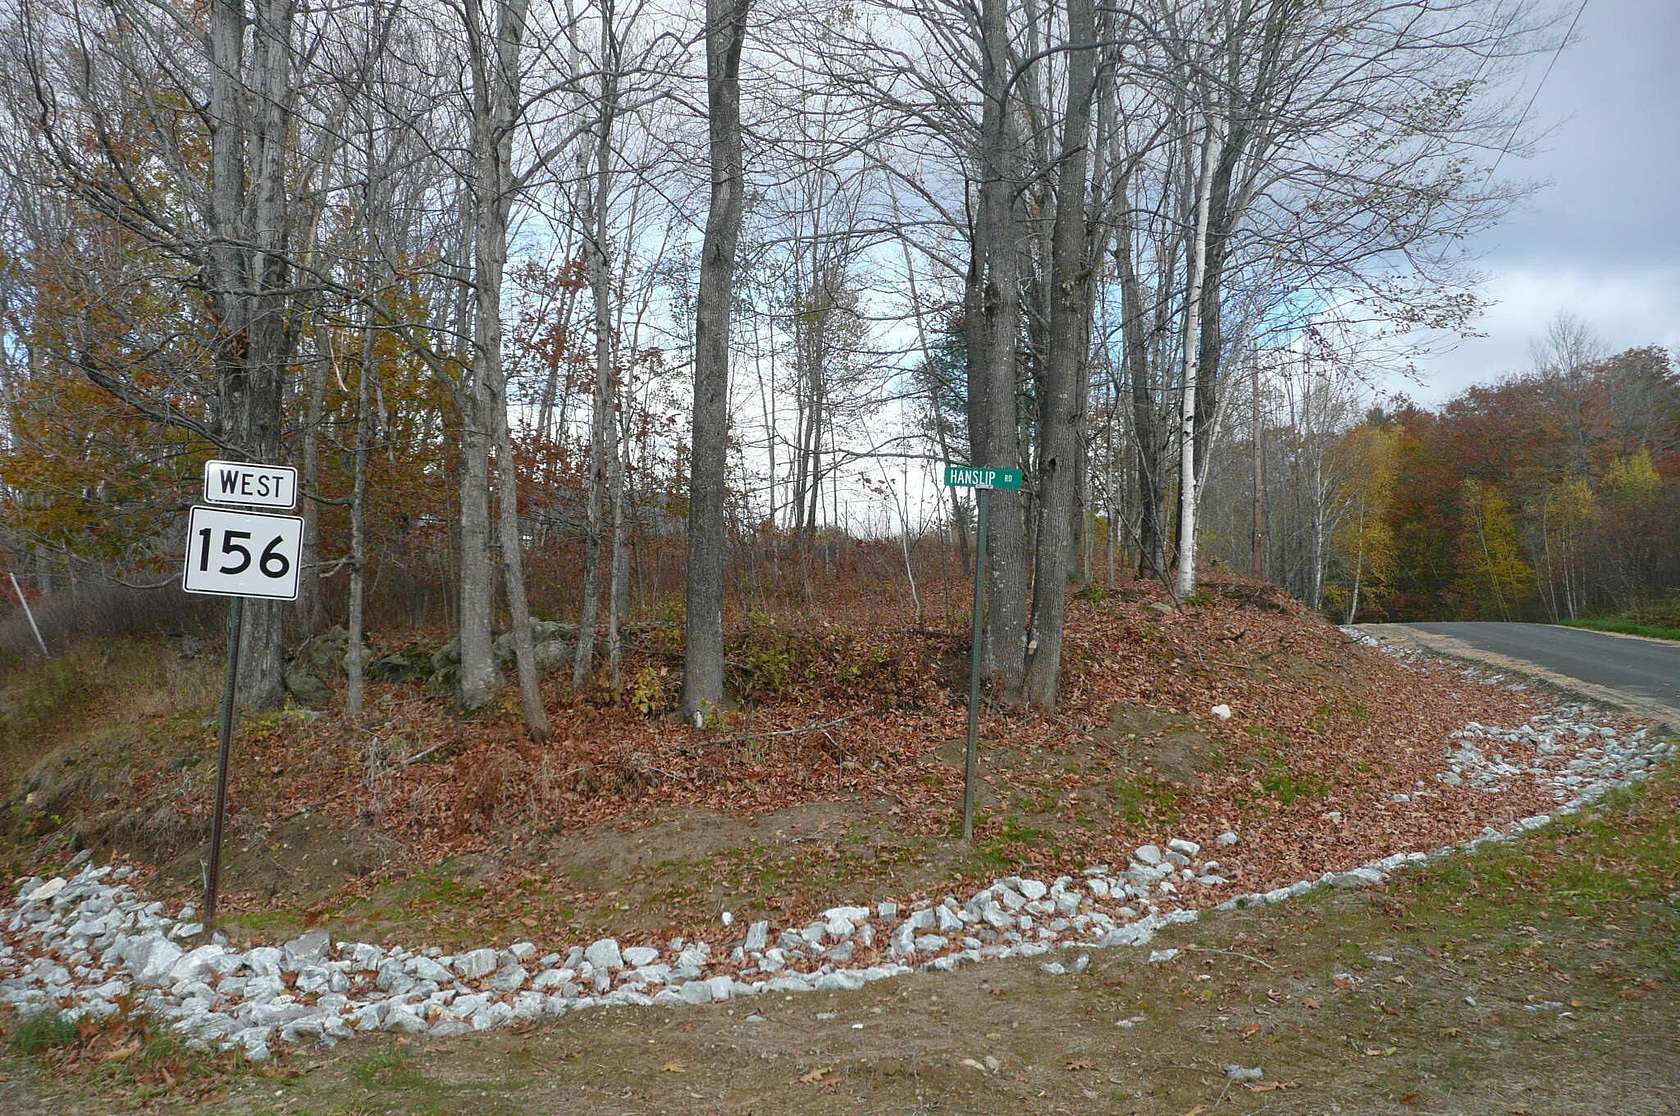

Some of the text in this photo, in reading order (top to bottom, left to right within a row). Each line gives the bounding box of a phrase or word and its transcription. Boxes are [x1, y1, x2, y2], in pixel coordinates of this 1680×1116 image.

[220, 469, 284, 498] WEST
[950, 469, 1013, 485] HANSLIP RD
[199, 528, 290, 578] 156
